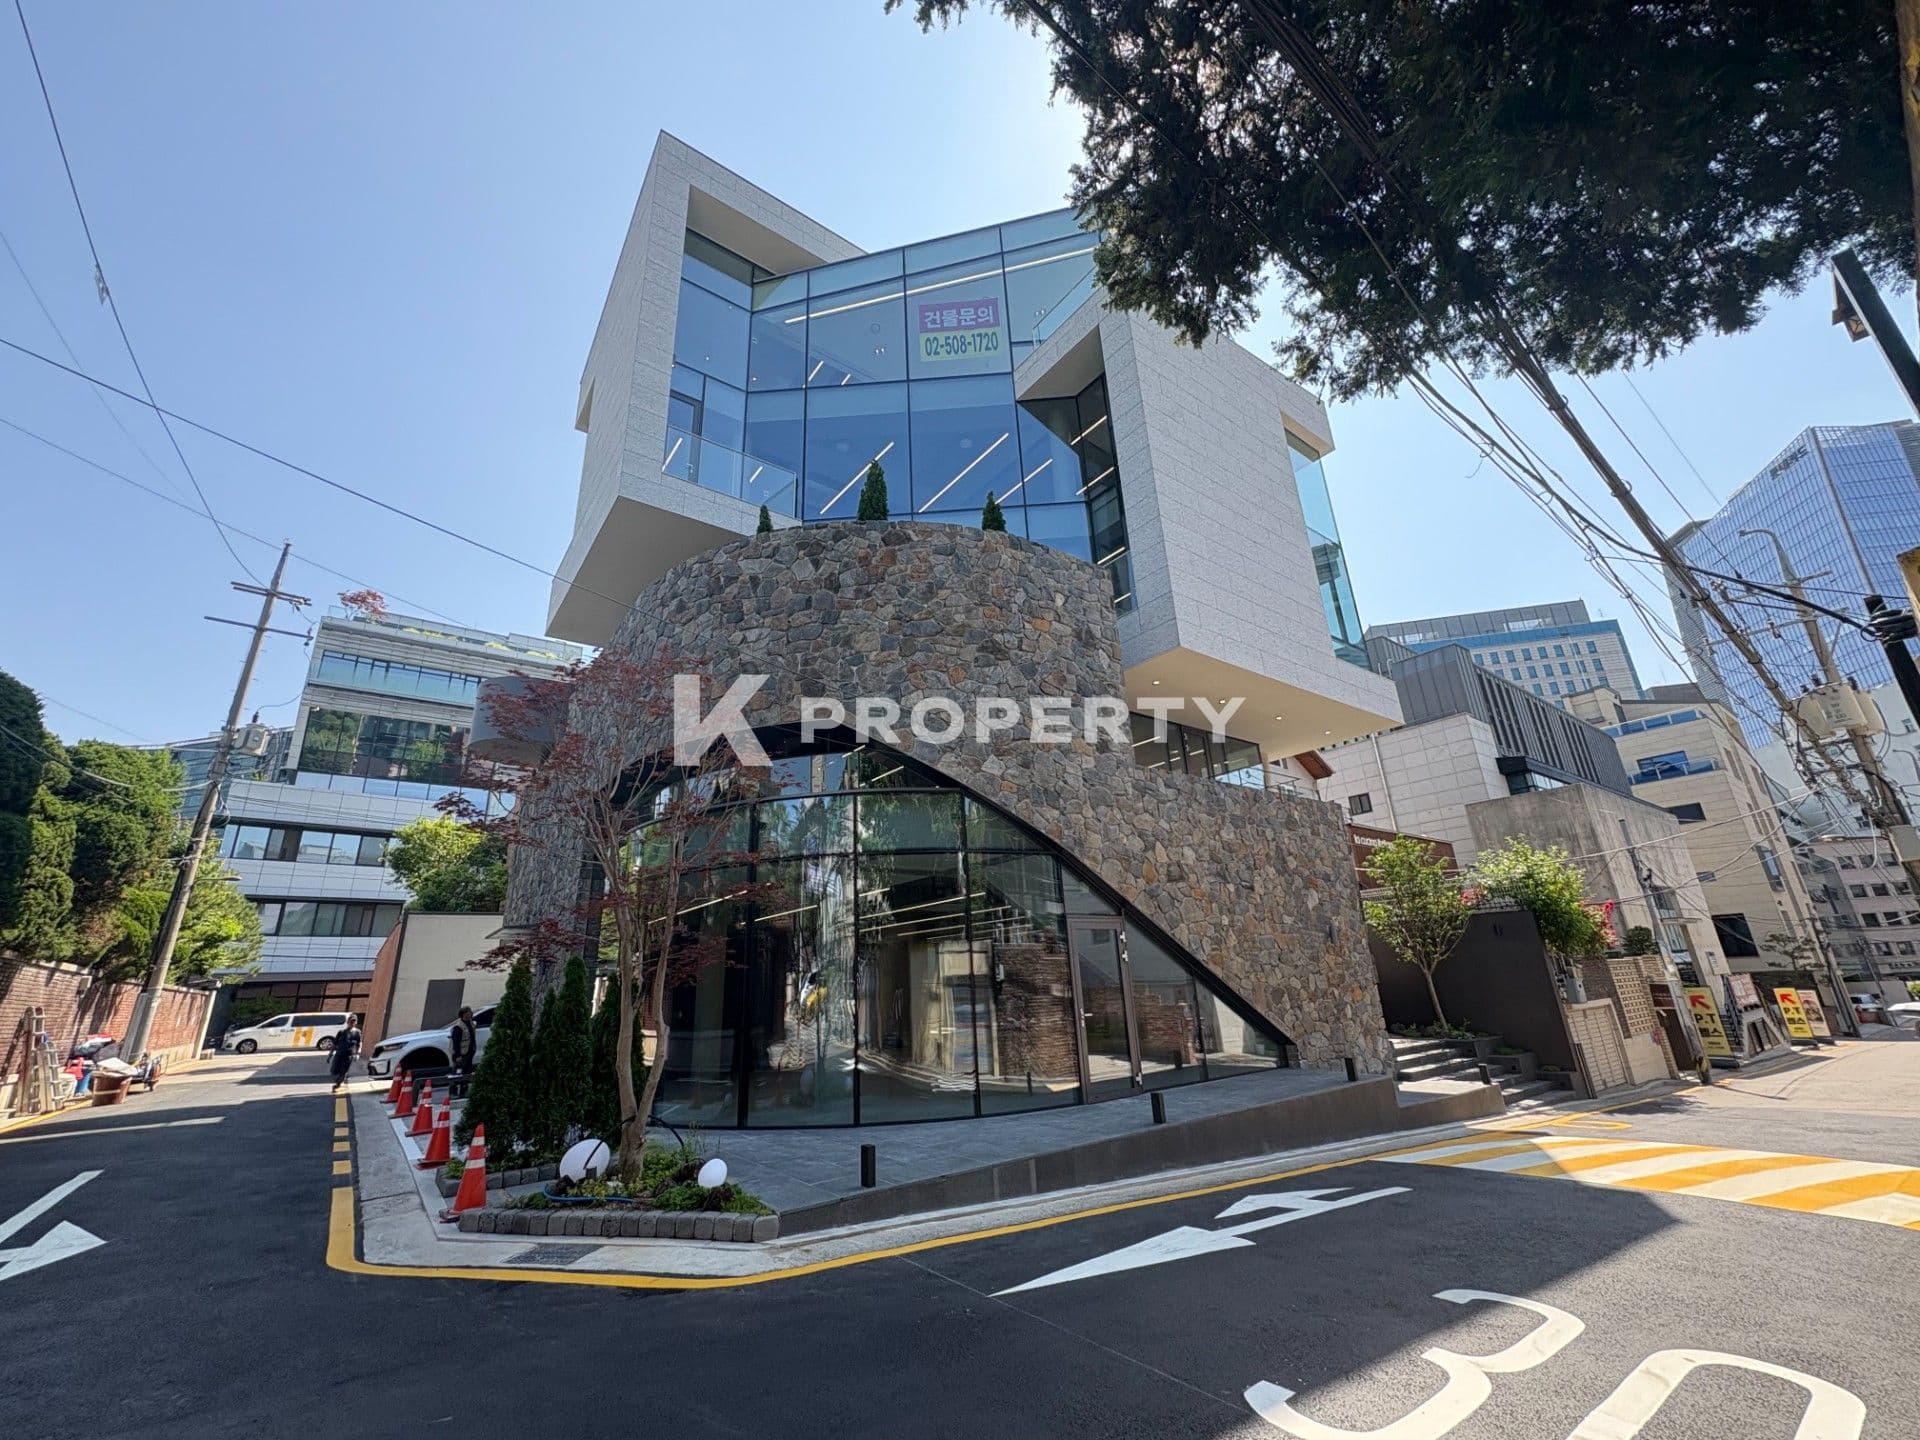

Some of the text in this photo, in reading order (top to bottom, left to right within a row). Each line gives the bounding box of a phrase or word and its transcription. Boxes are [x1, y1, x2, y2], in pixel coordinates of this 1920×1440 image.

[924, 305, 994, 328] 건물문의
[924, 331, 999, 356] 02-508-1720
[1694, 1013, 1716, 1024] P.T
